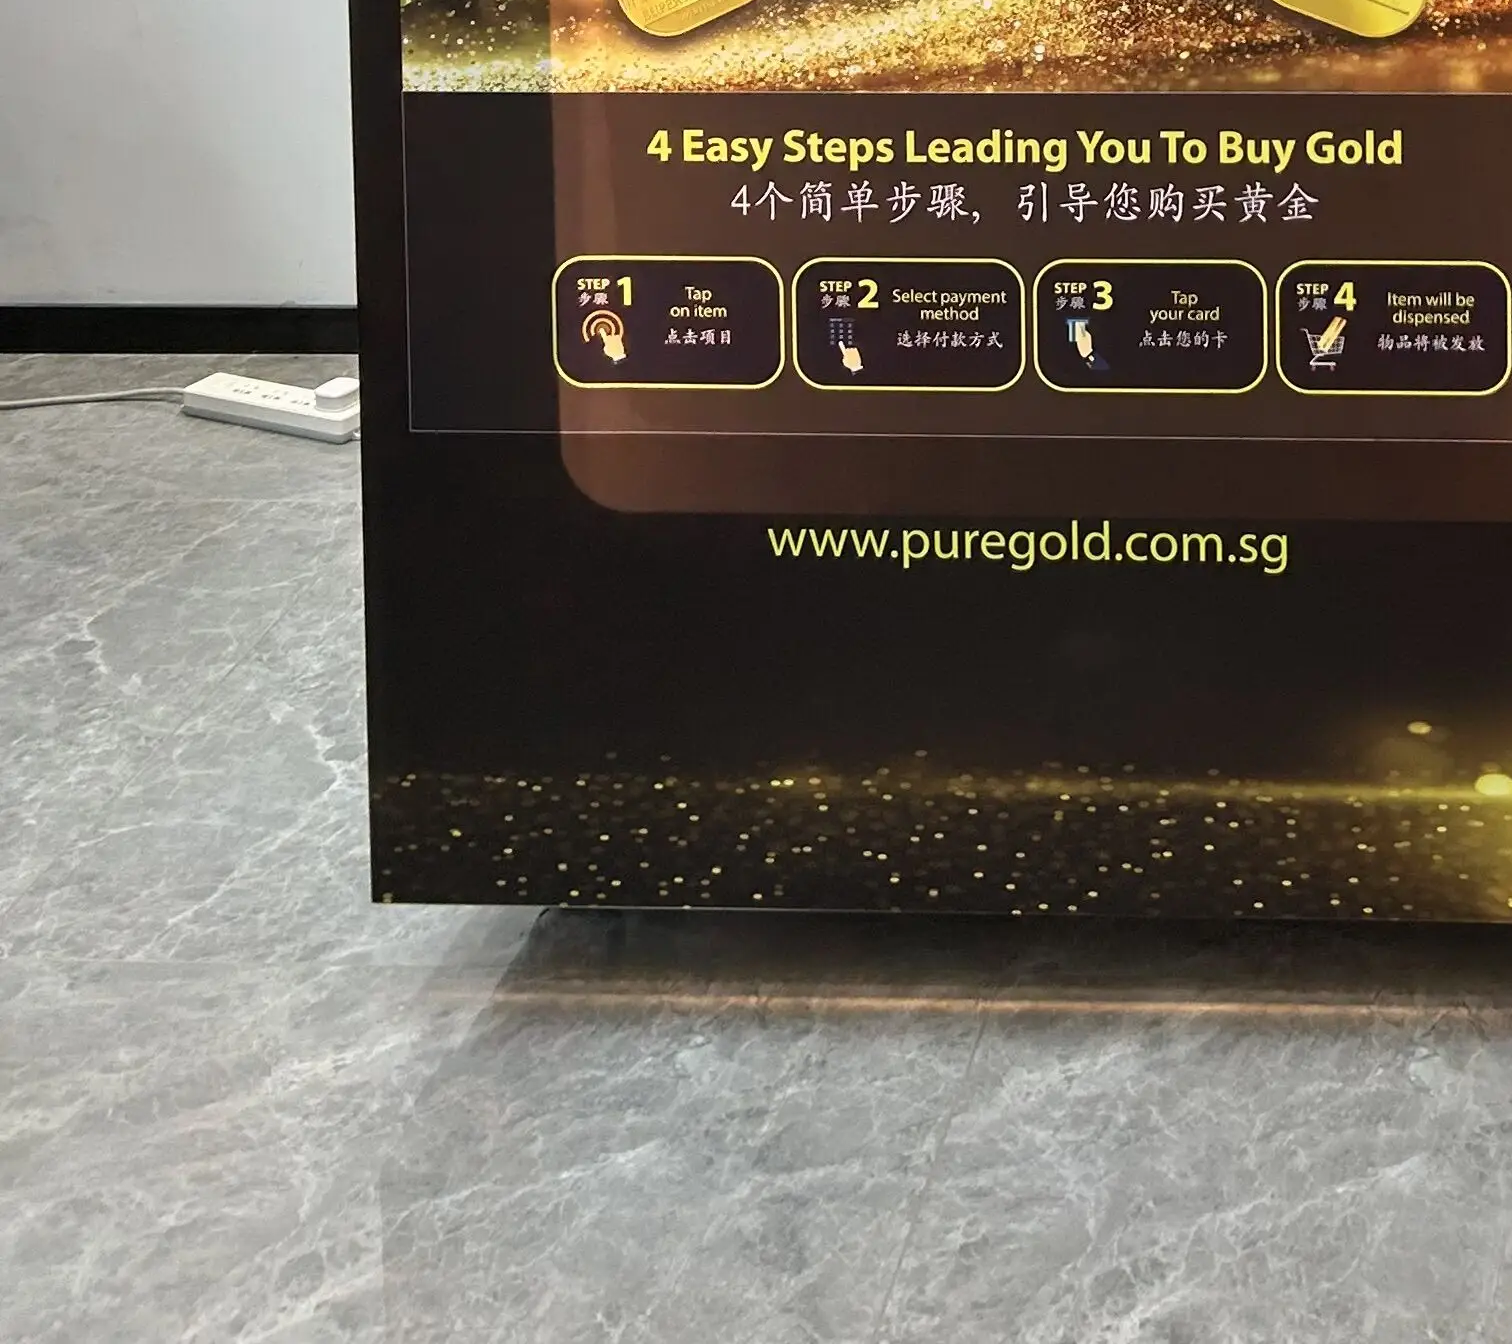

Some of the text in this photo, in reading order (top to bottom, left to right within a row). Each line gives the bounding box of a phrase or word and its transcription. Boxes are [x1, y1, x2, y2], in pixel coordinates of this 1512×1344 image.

[646, 129, 1402, 174] 4 Easy Steps Leading You To Buy Gold
[577, 277, 632, 306] STEP 1
[684, 286, 712, 303] Tap
[819, 279, 879, 309] STEP 2
[892, 289, 1007, 307] Select payment
[1054, 280, 1114, 310] STEP 3
[1171, 290, 1199, 307] Tap
[1296, 282, 1357, 311] STEP 4
[1387, 292, 1475, 307] Item will be
[670, 305, 727, 318] on item
[920, 307, 979, 321] method
[1150, 307, 1220, 324] your card
[1392, 310, 1471, 327] dispensed
[665, 328, 732, 345] 点击项目
[897, 331, 1004, 349] 选择付款方式
[1139, 330, 1228, 349] 点击您的卡
[1377, 334, 1486, 352] 物品将被发放
[767, 520, 1288, 575] www.puregold.com.sg
